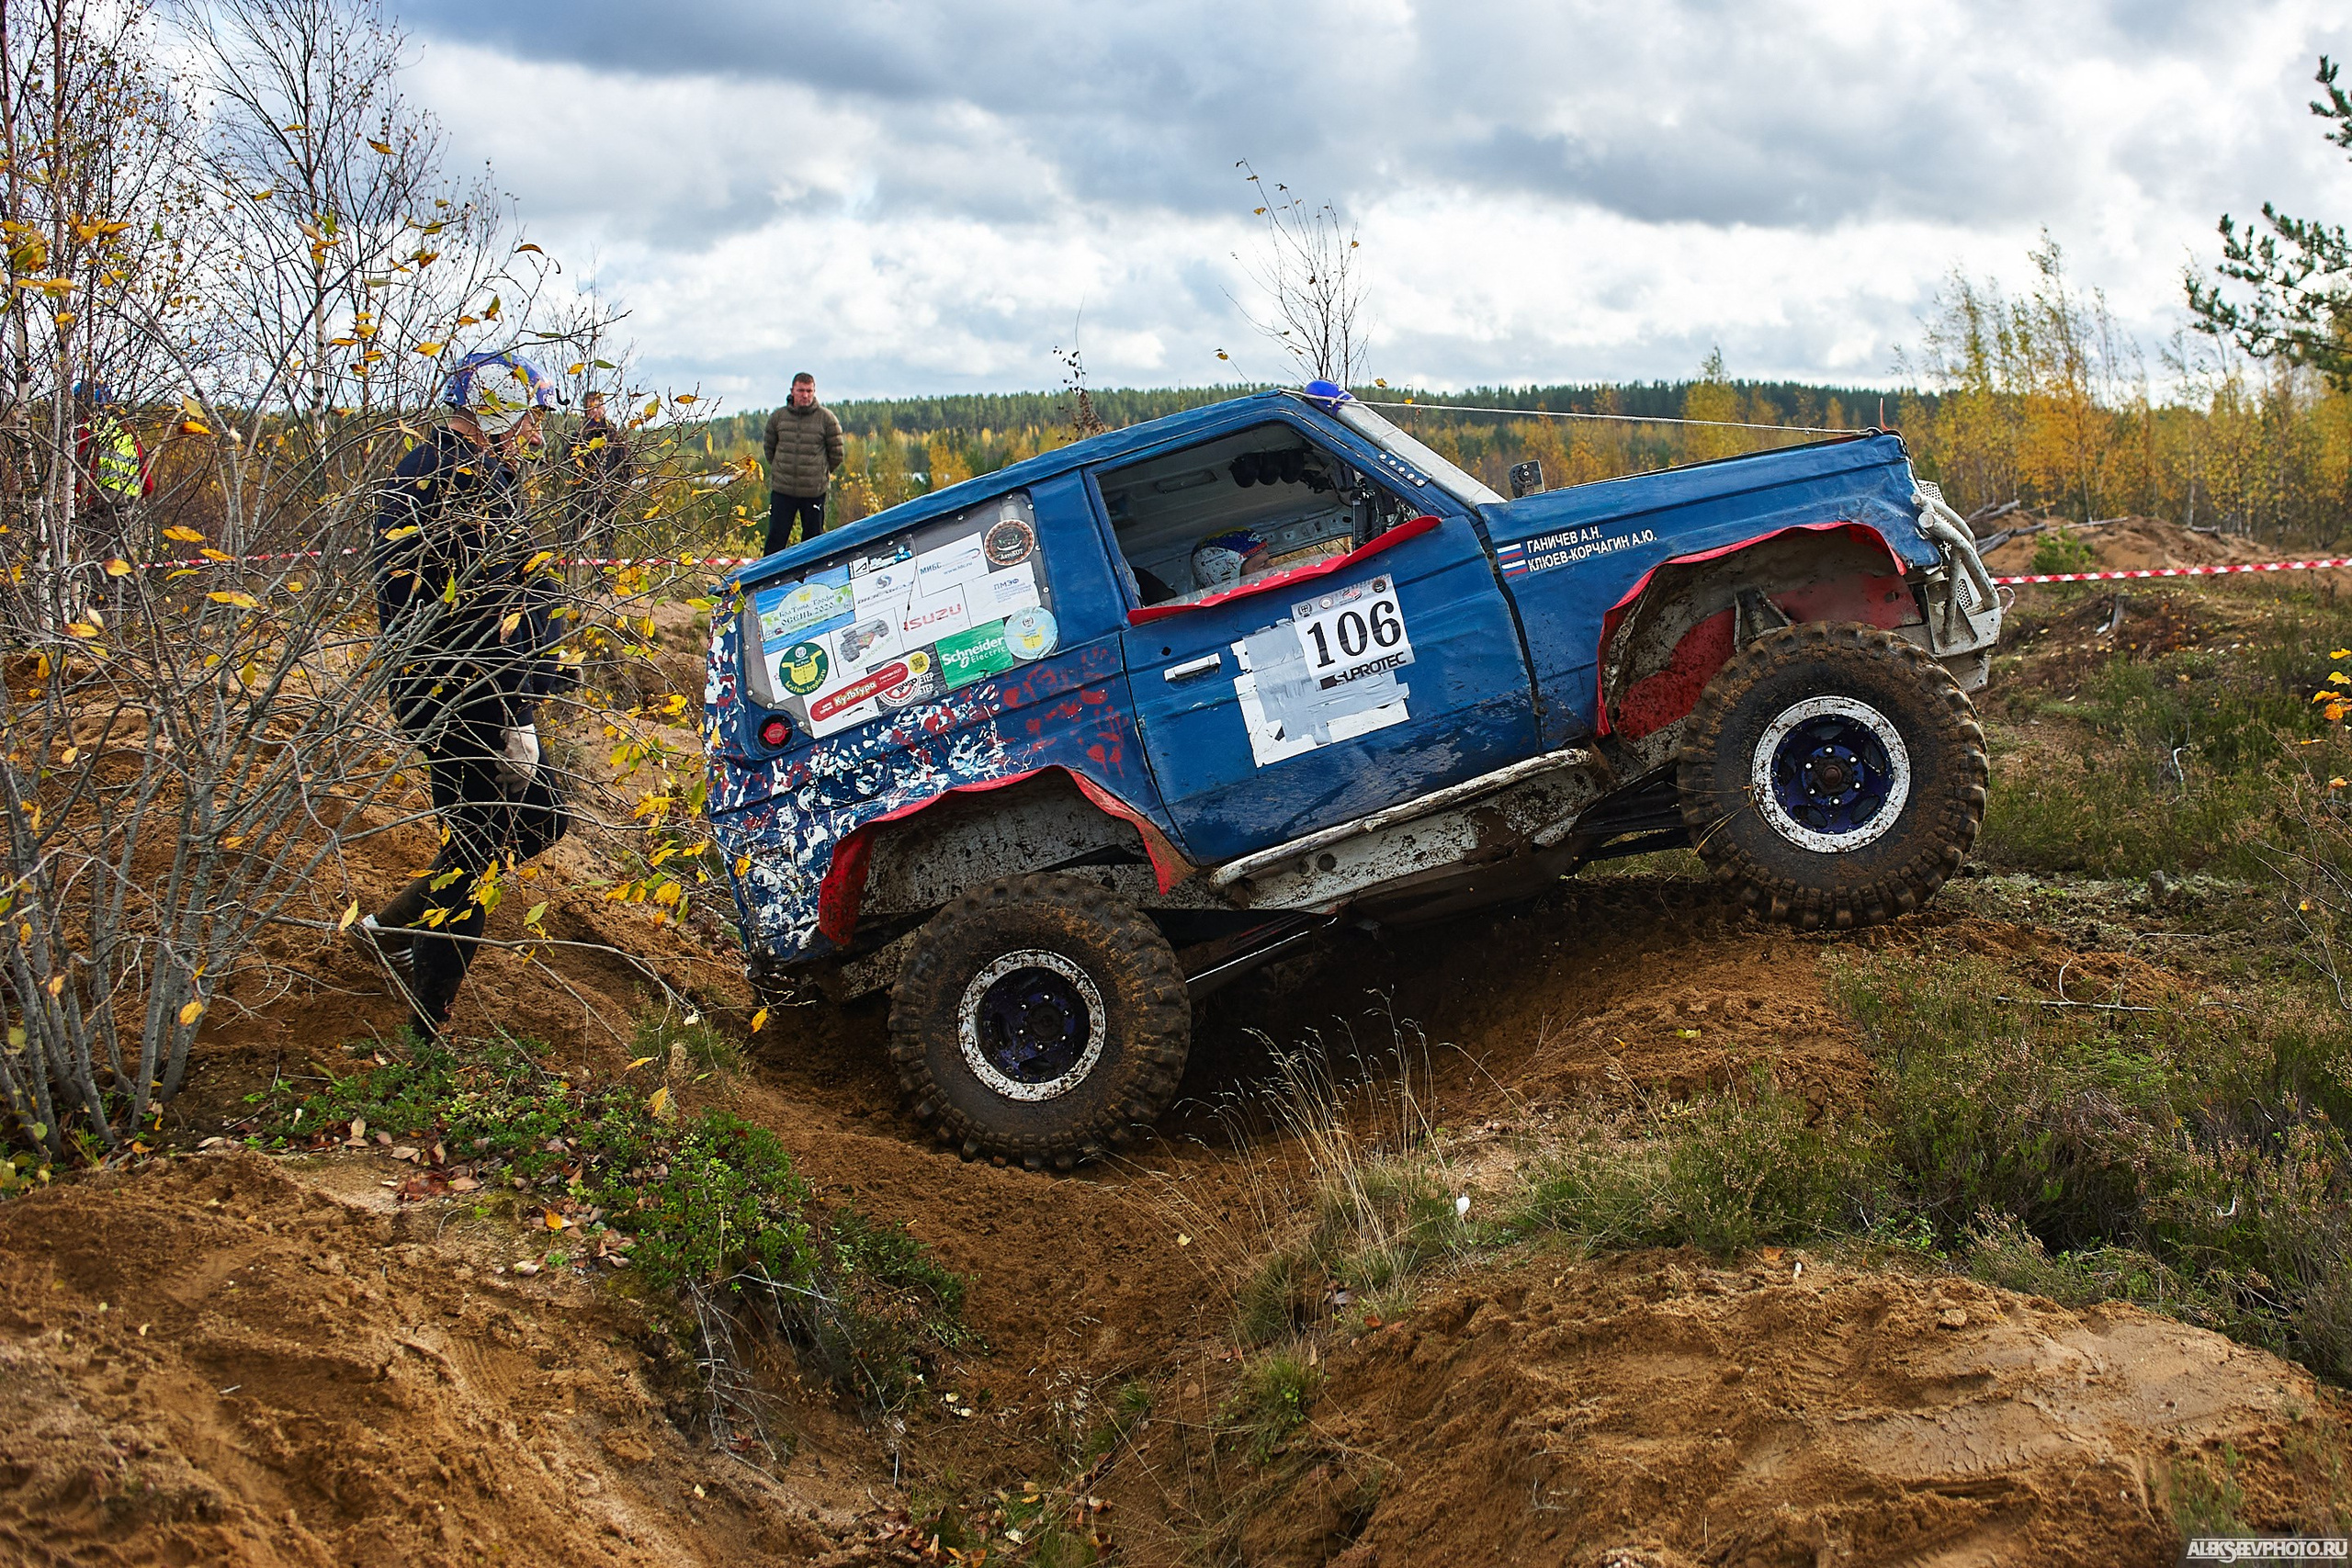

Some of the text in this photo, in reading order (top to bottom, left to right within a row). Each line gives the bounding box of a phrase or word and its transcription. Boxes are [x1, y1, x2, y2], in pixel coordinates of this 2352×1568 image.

[1526, 525, 1603, 554] ГАНИЧЕВ А.Н.
[1527, 528, 1657, 572] КЛЮЕВ-КОРЧАГИН А.Ю.
[920, 561, 943, 575] МИБС
[993, 578, 1020, 591] ПМЭФ
[781, 610, 813, 626] ОСЕНЬ
[814, 602, 835, 615] 2020
[903, 603, 962, 633] ISUZU
[1307, 600, 1401, 669] 106
[941, 637, 1005, 666] Schneider
[970, 647, 1007, 664] Electric
[1334, 651, 1407, 685] SUPROTEC
